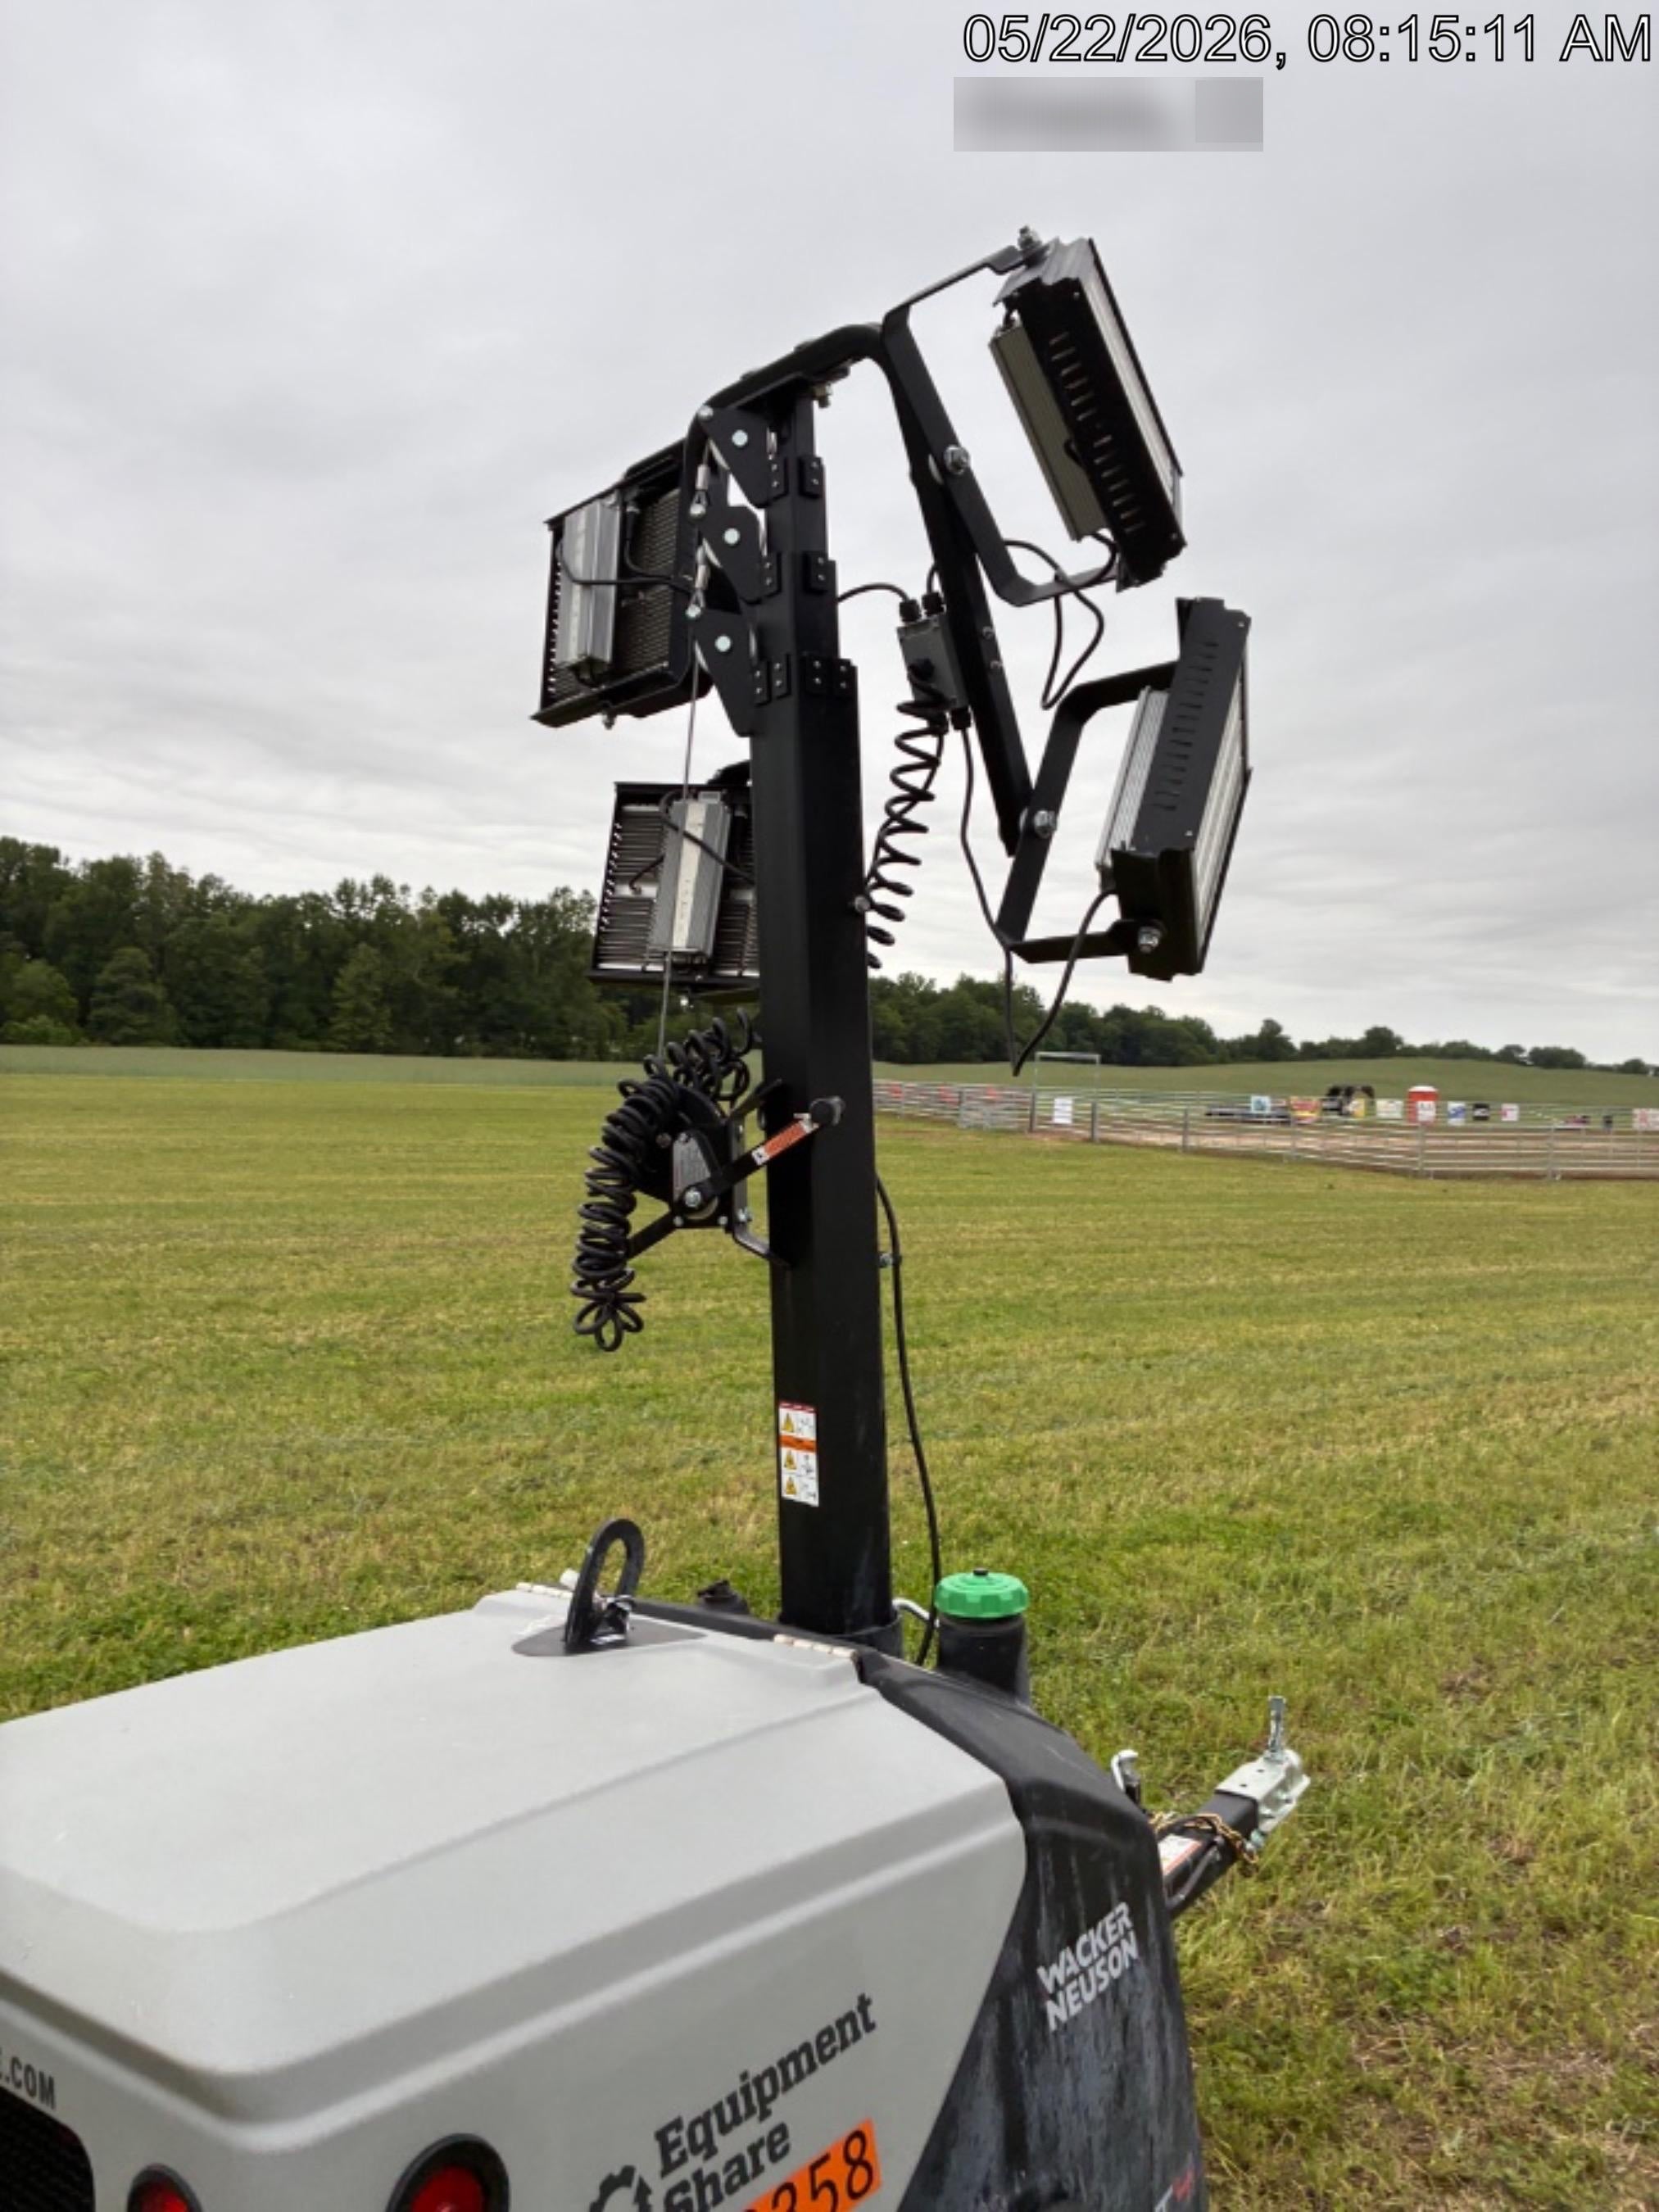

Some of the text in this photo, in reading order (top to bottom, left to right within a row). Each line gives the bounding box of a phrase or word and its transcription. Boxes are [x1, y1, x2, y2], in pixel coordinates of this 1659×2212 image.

[1037, 1902, 1133, 1995] WACKER
[1045, 1929, 1139, 2031] NEUSON
[0, 2046, 55, 2110] .COM
[655, 1992, 877, 2178] Equipment
